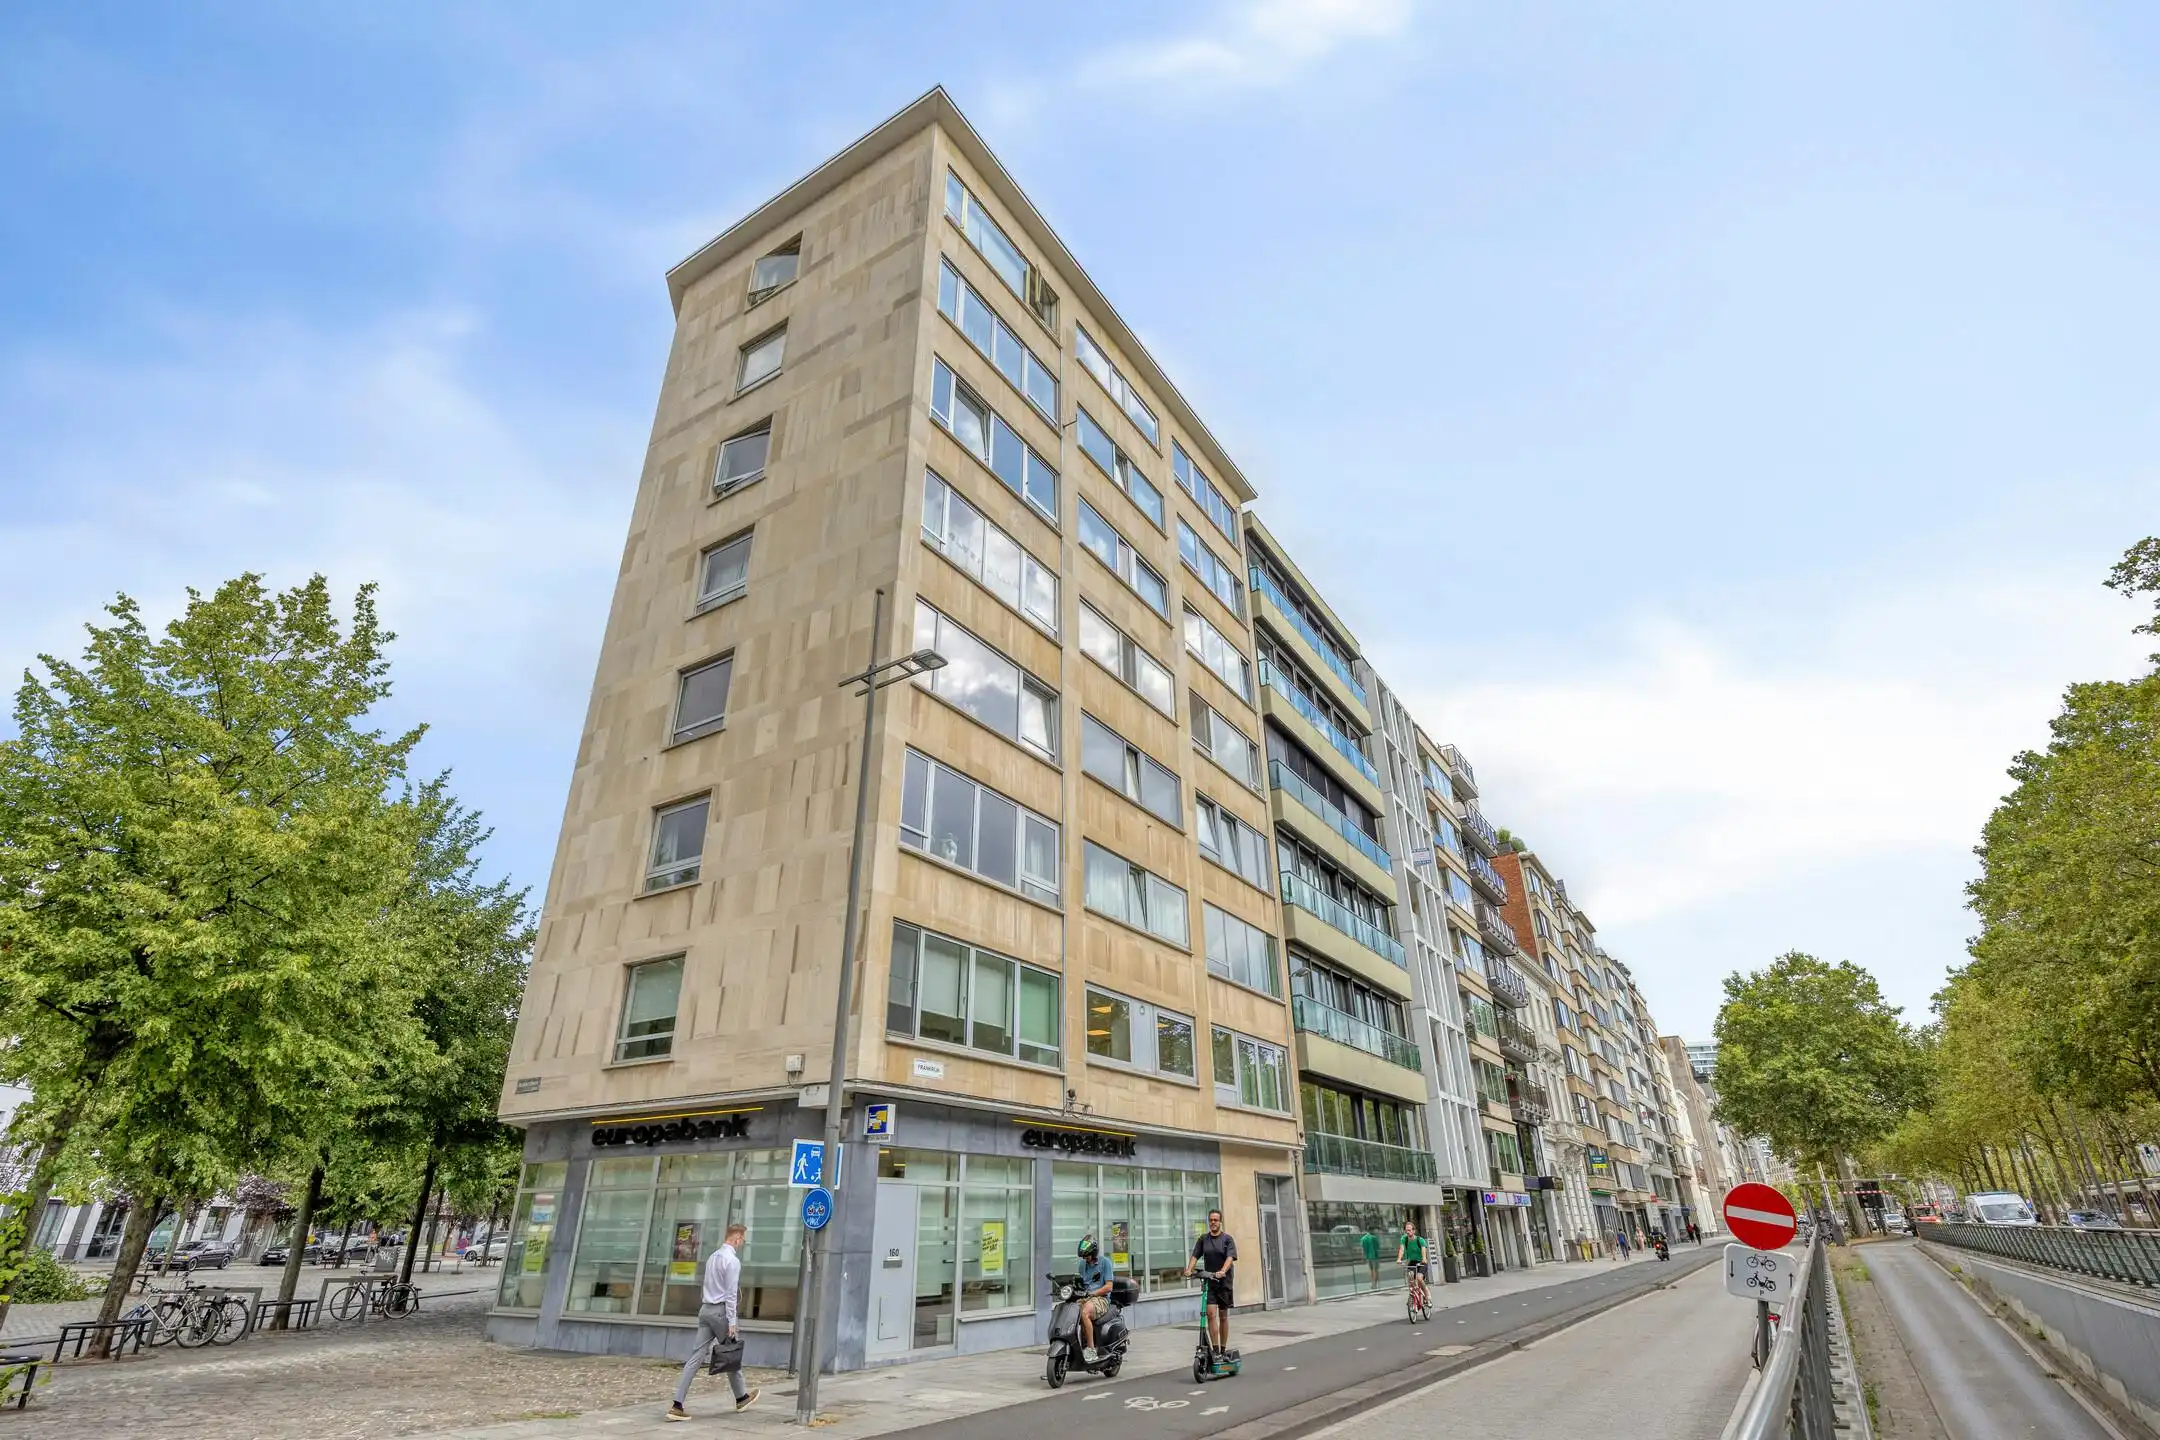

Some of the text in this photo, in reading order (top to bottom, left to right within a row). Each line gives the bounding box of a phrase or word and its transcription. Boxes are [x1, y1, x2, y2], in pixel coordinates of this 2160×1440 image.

[592, 1113, 751, 1147] europabank
[1022, 1129, 1137, 1156] europabank
[889, 1248, 900, 1257] 160
